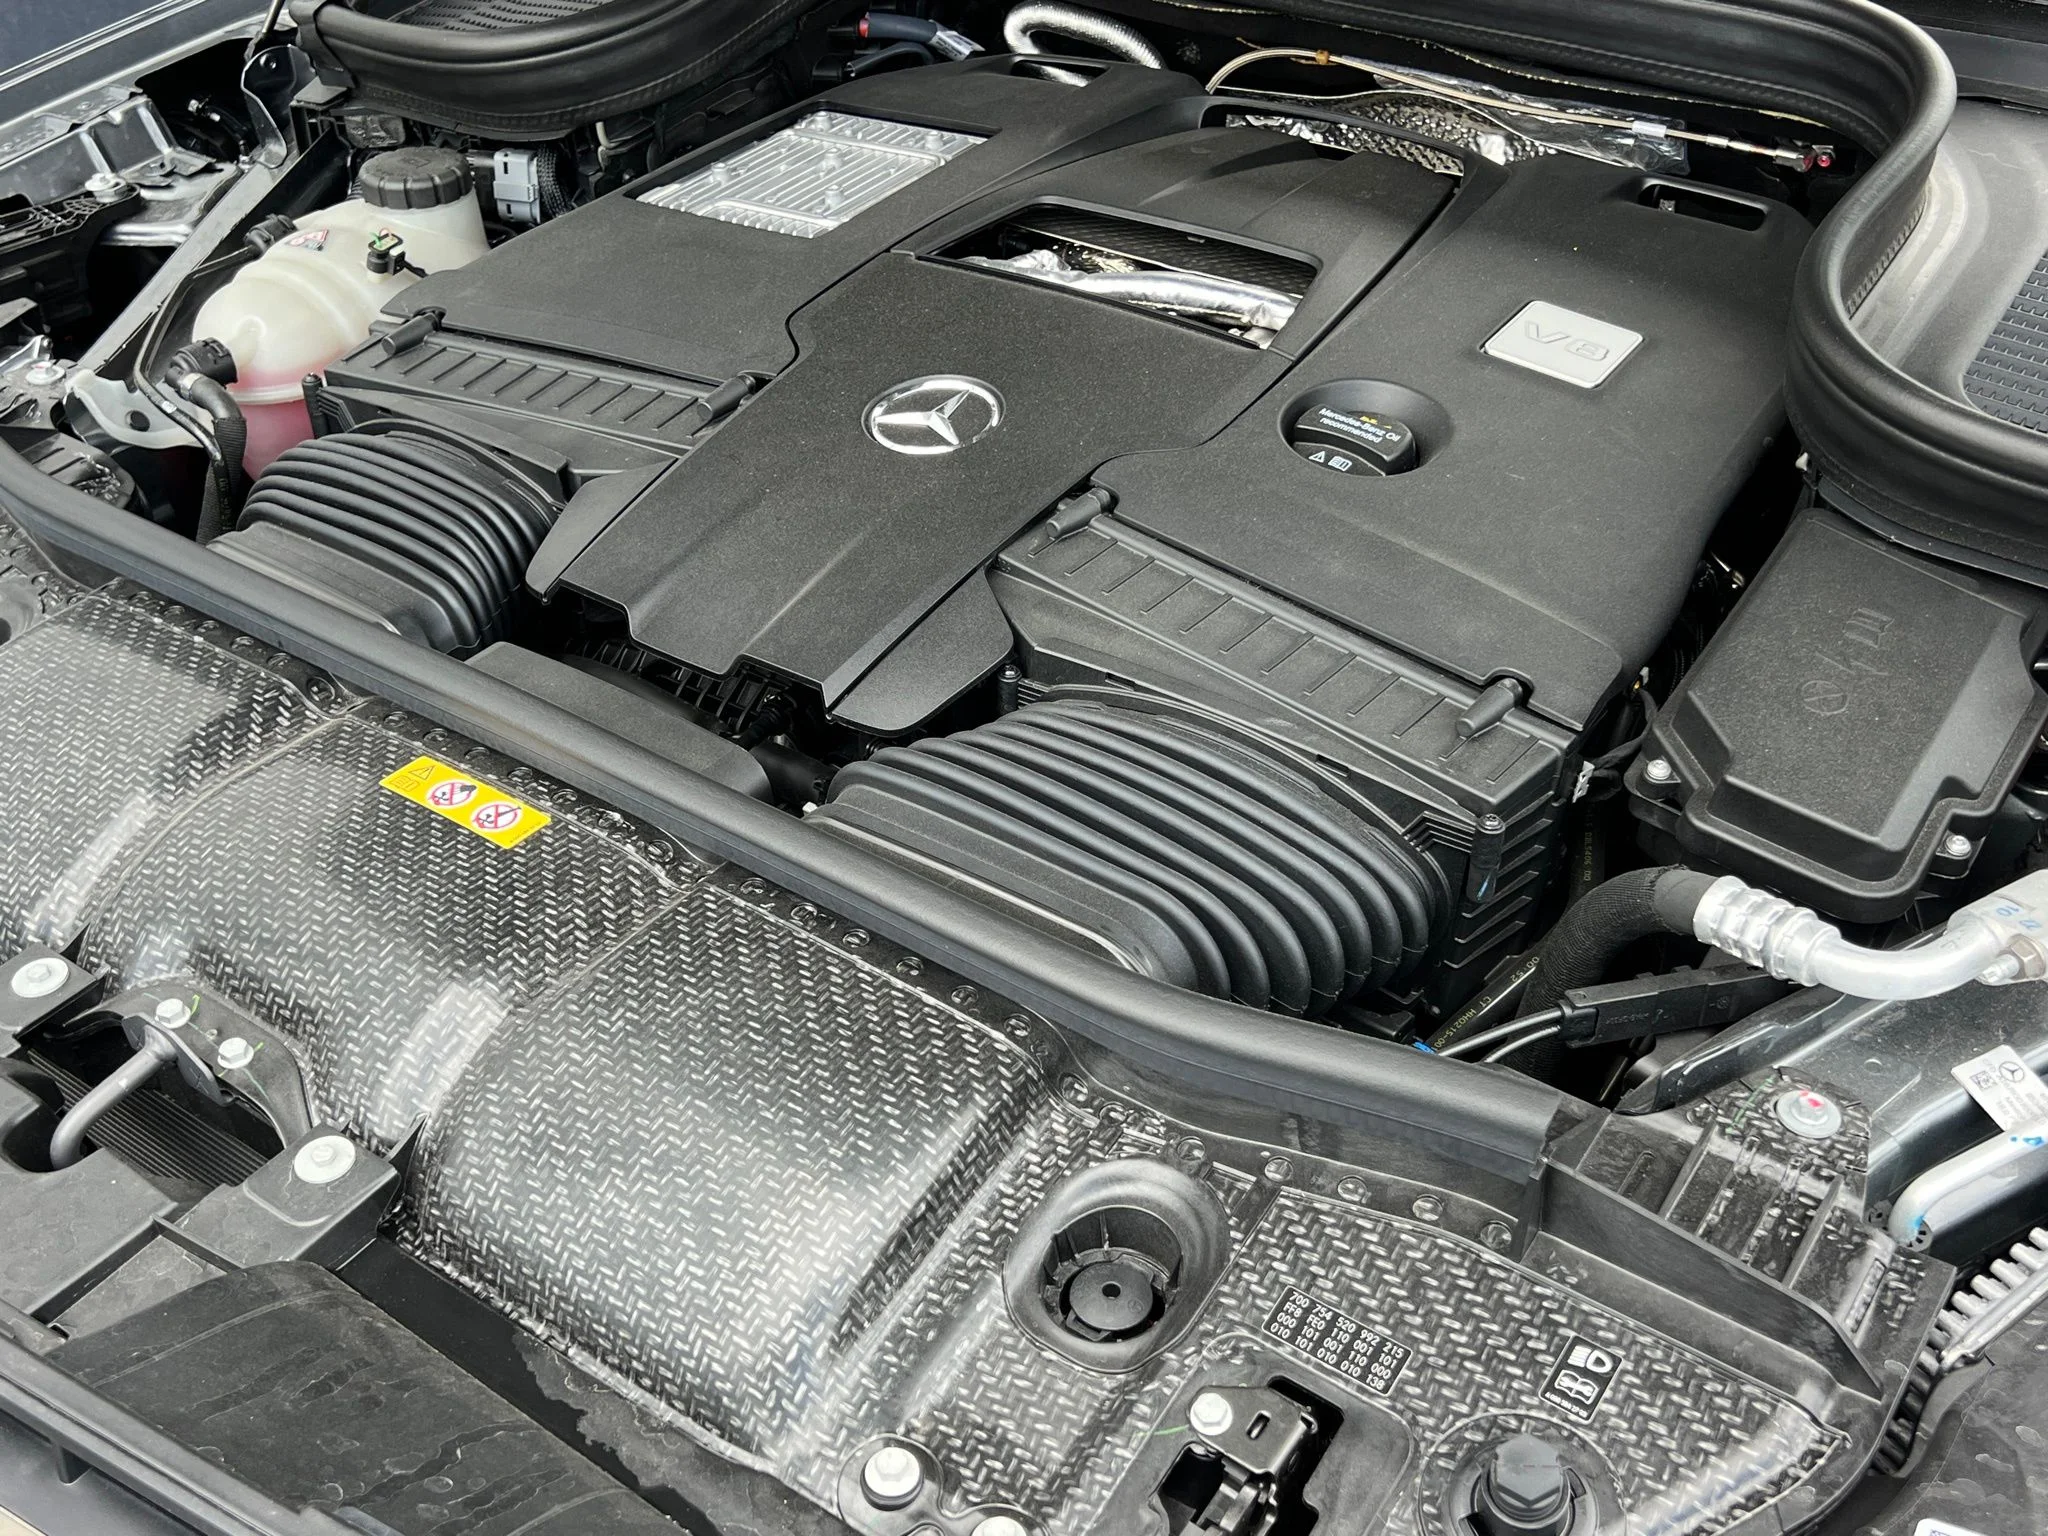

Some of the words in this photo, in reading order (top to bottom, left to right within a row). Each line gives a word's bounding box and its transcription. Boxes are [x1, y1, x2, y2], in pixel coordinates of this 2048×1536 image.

[1525, 321, 1609, 361] V8
[1319, 408, 1386, 436] Mercedes-Benz
[1385, 432, 1401, 442] Oil
[1320, 417, 1382, 443] recommended
[1270, 1322, 1290, 1339] 010
[1295, 1336, 1313, 1352] 101
[1317, 1348, 1336, 1364] 010
[1340, 1360, 1361, 1377] 010
[1365, 1374, 1386, 1390] 138
[1277, 1312, 1296, 1328] 000
[1301, 1325, 1320, 1341] 101
[1323, 1337, 1344, 1353] 001
[1348, 1350, 1367, 1366] 110
[1370, 1363, 1391, 1379] 000
[1283, 1302, 1302, 1318] FF8
[1306, 1314, 1325, 1330] FE0
[1331, 1328, 1350, 1344] 110
[1353, 1340, 1374, 1356] 001
[1379, 1353, 1398, 1369] 101
[1289, 1291, 1309, 1308] 700
[1312, 1304, 1333, 1320] 754
[1336, 1317, 1356, 1333] 520
[1360, 1330, 1380, 1346] 992
[1383, 1342, 1404, 1358] 215
